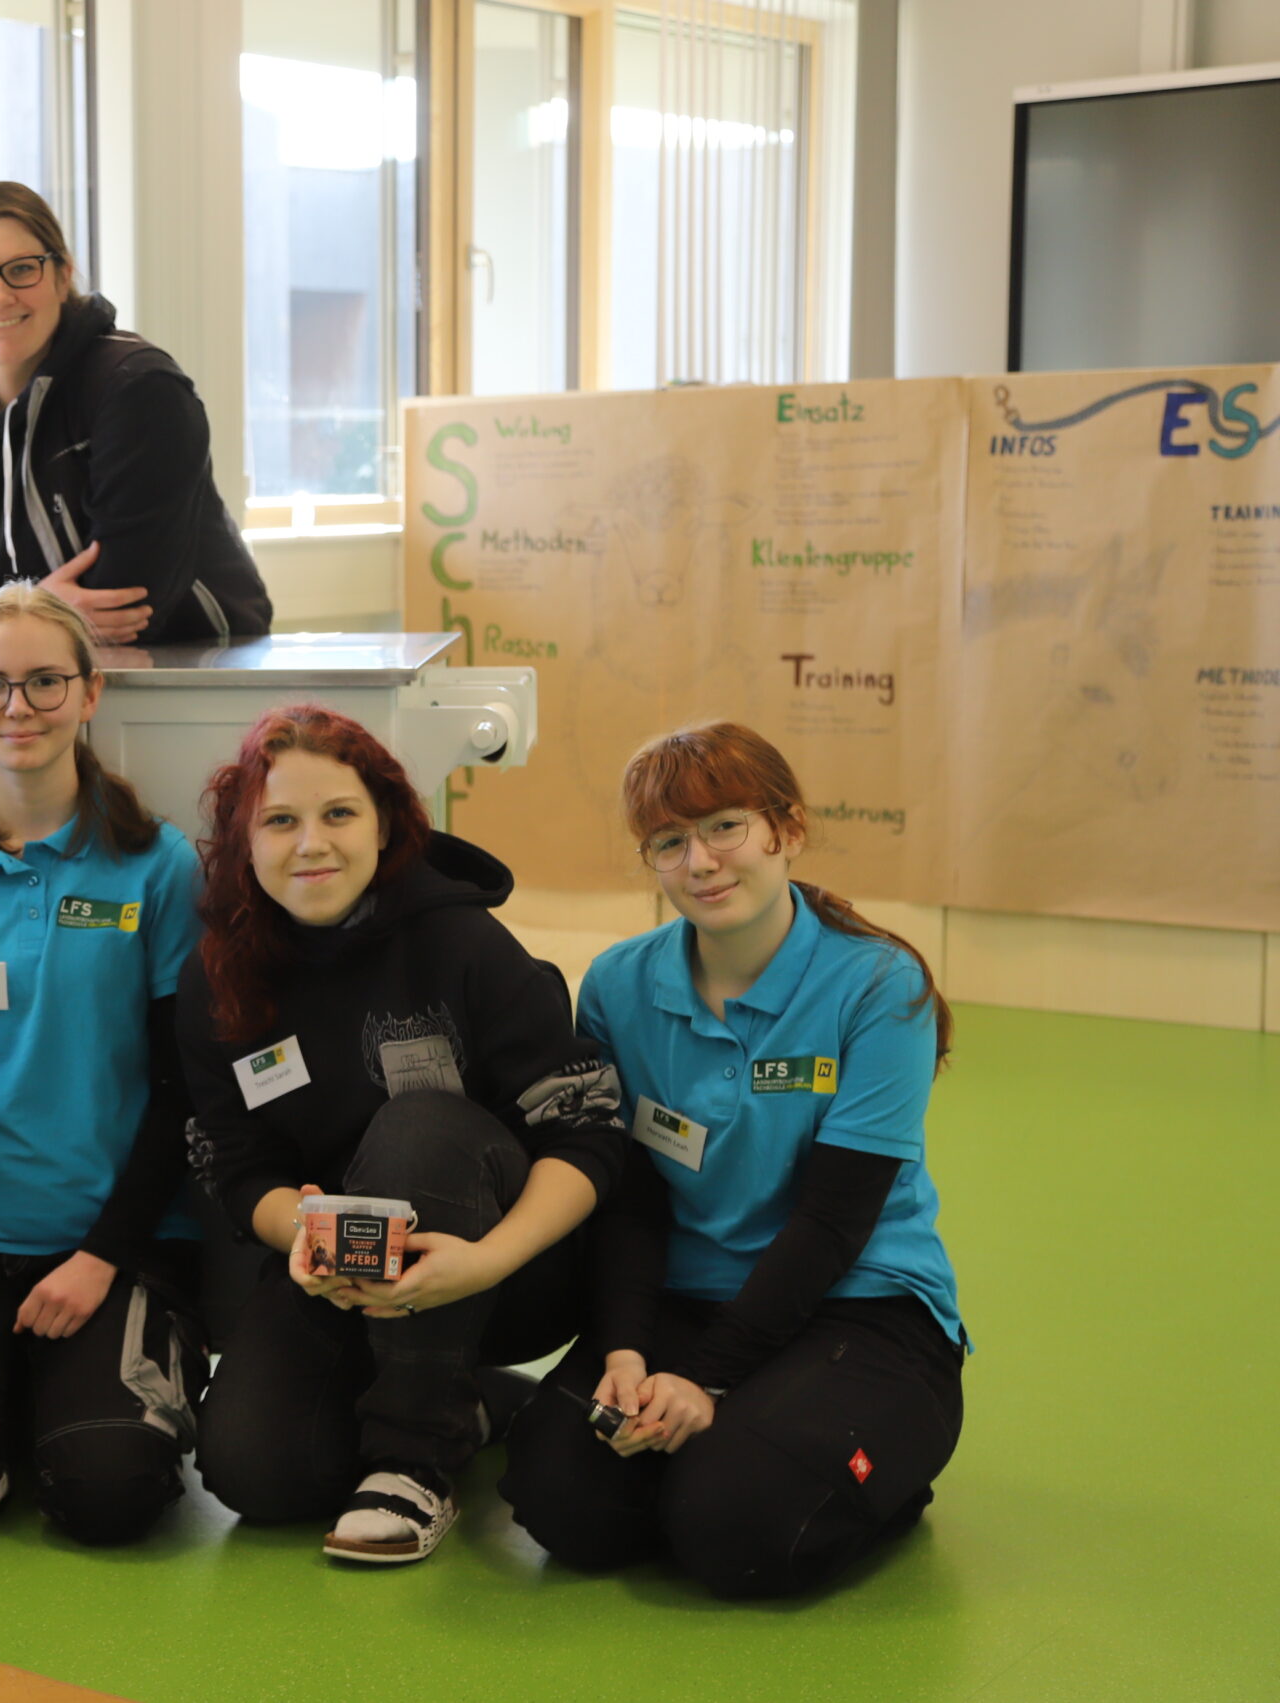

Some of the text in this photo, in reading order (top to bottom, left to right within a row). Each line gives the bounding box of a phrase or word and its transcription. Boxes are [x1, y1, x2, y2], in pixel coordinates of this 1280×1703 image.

[776, 391, 866, 424] Einsatz
[990, 435, 1057, 457] INFOS
[481, 529, 588, 552] Methoden
[751, 537, 916, 576] Klientengruppe
[484, 623, 558, 658] Rassen
[780, 652, 896, 706] Training
[60, 899, 92, 917] LFS
[753, 1062, 788, 1078] LFS
[344, 1253, 379, 1266] PFERD
